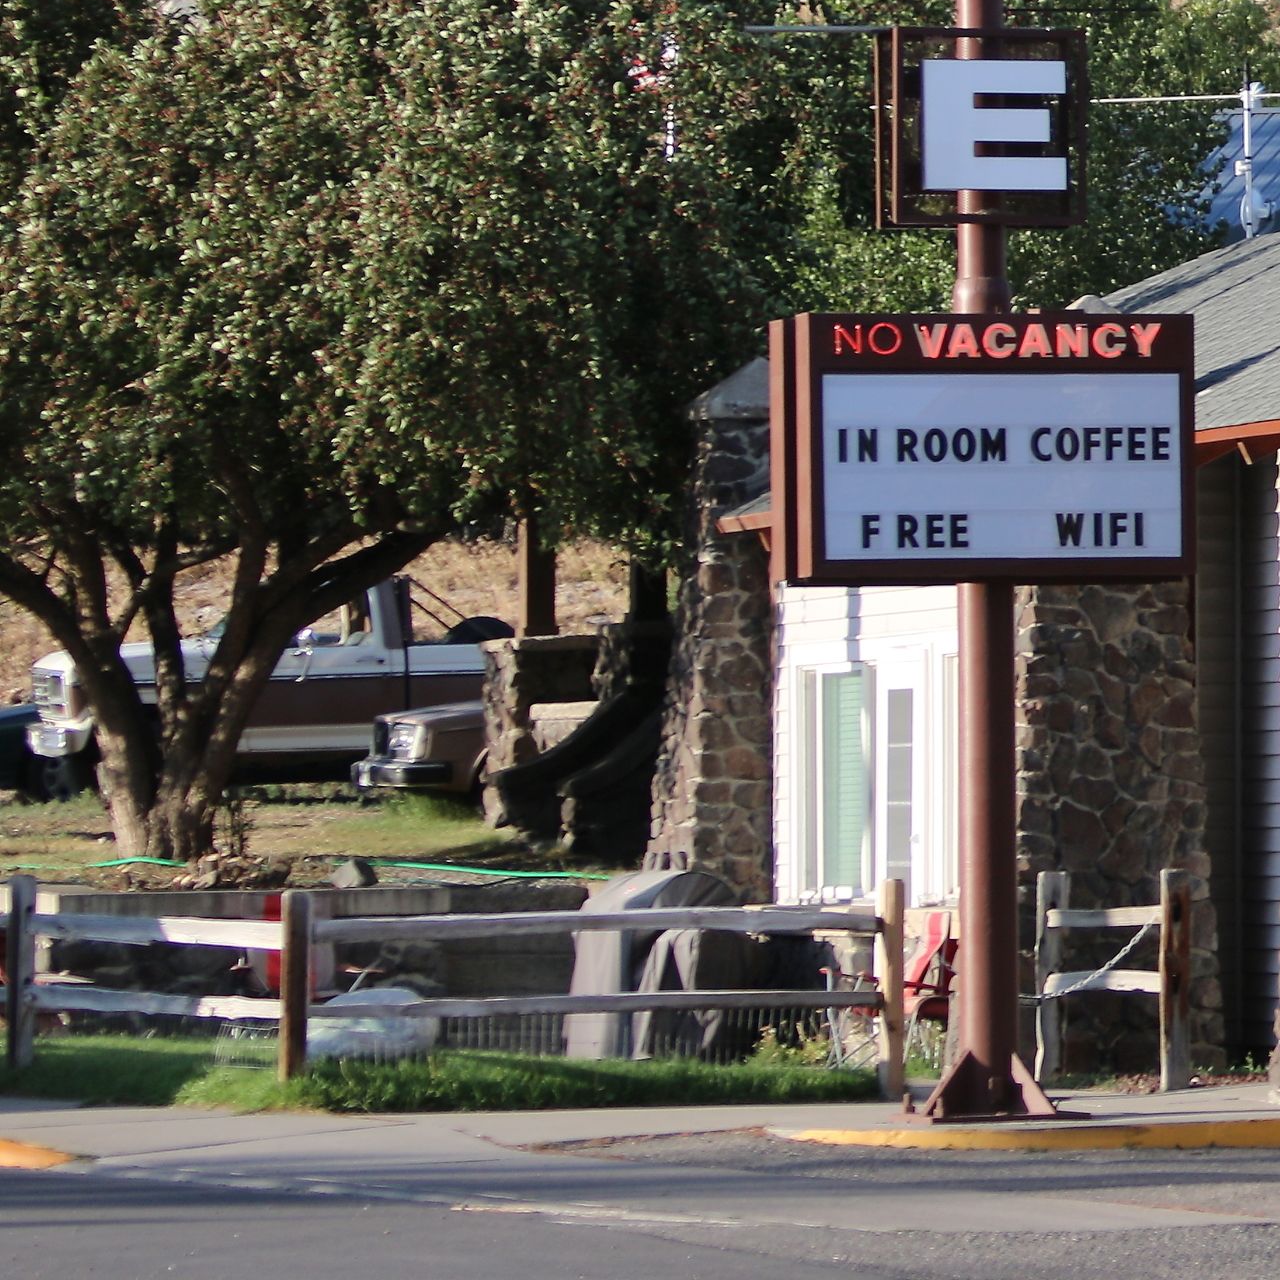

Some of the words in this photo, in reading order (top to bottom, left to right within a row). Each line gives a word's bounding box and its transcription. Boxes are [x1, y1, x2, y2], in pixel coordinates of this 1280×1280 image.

[833, 322, 902, 355] NO
[913, 322, 1162, 359] VACANCY
[837, 427, 879, 463] IN
[896, 427, 1007, 463] ROOM
[1030, 426, 1171, 462] COFFEE
[861, 513, 970, 549] FREE
[1055, 512, 1144, 548] WIFI
